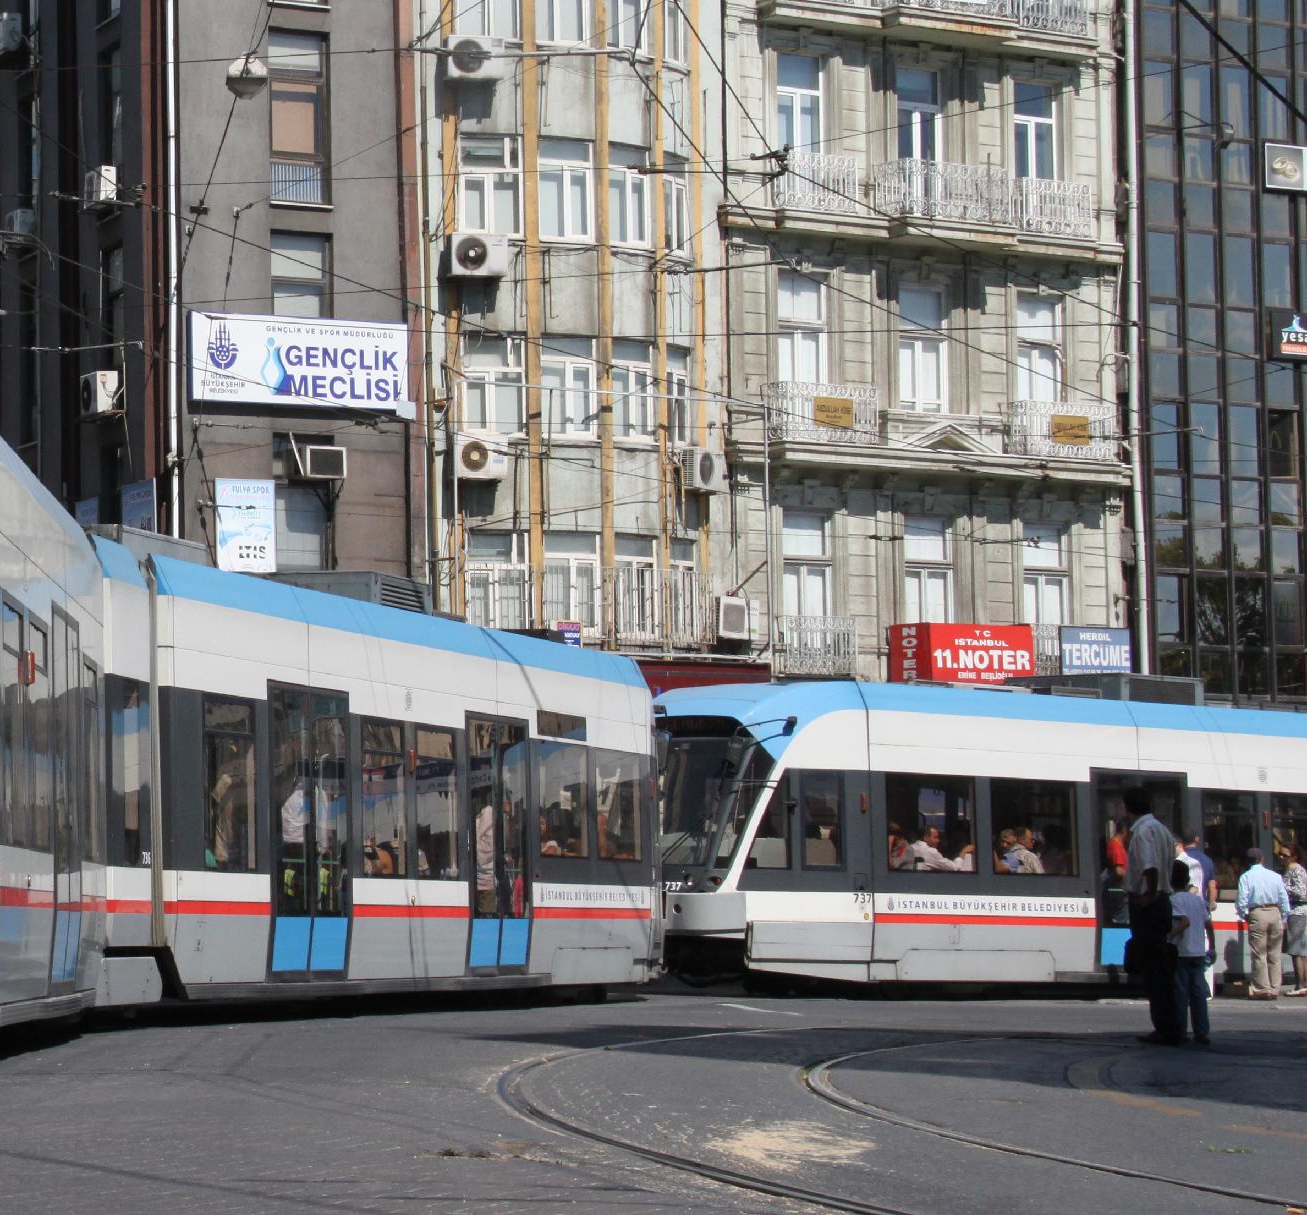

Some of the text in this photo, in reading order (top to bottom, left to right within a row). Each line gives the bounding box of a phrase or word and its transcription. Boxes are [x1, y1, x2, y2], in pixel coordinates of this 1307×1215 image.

[285, 345, 398, 375] GENÇLİK
[287, 373, 399, 401] MECLİSİ
[933, 649, 1031, 670] 11.NOTER
[1062, 644, 1131, 666] TERCÜME
[665, 881, 682, 891] 737
[854, 893, 872, 904] 737
[898, 898, 1079, 913] İSTANBUL BÜYÜKŞEHİR BELEDİYESİ
